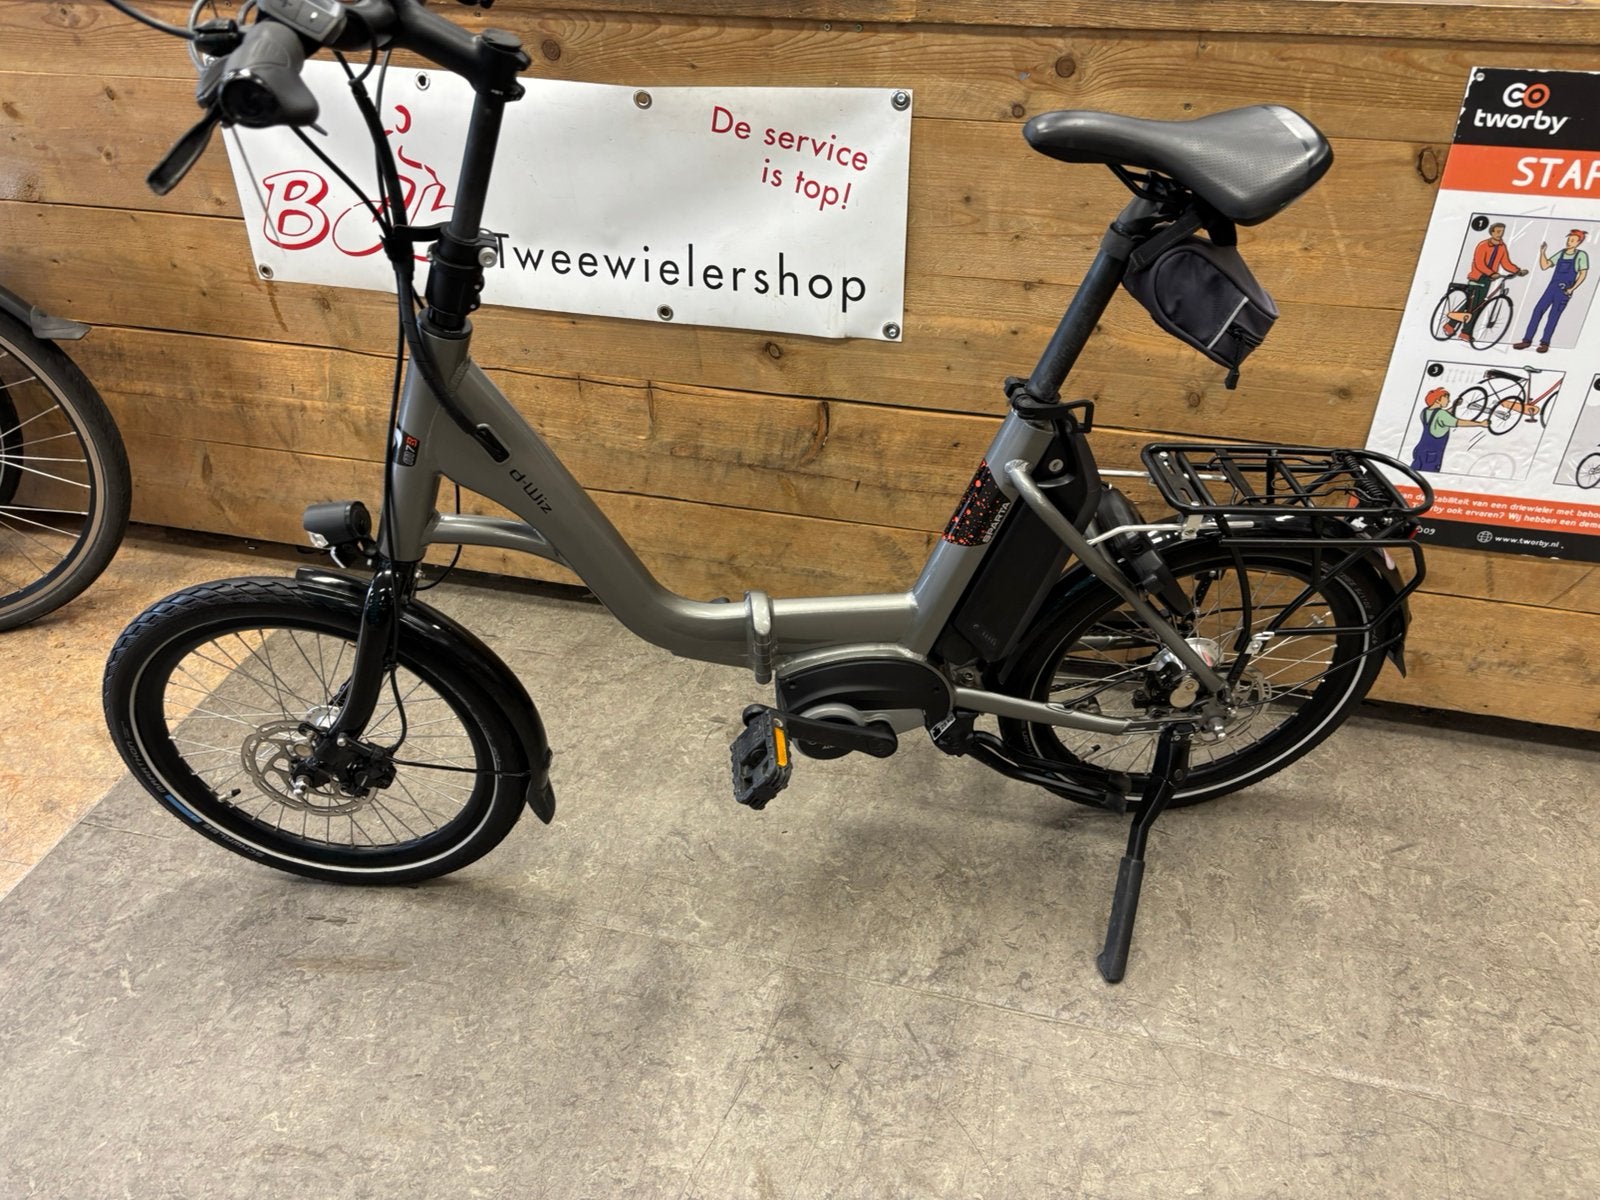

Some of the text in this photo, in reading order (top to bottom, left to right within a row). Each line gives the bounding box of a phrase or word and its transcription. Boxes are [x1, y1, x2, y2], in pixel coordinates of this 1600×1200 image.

[711, 105, 869, 172] De service
[1473, 108, 1569, 136] tworby
[761, 158, 852, 212] is top!
[493, 232, 867, 313] Tweewielershop
[982, 501, 1011, 544] SPARTA
[1433, 495, 1469, 506] tabiliteit
[1472, 500, 1489, 508] van
[1490, 502, 1507, 510] een
[1509, 502, 1555, 515] driewieler
[1556, 508, 1576, 517] met
[1577, 510, 1600, 520] beho
[1446, 506, 1464, 515] ook
[1465, 509, 1505, 520] ervaren?
[1508, 512, 1522, 523] Wij
[1523, 515, 1558, 526] hebben
[1559, 518, 1577, 528] een
